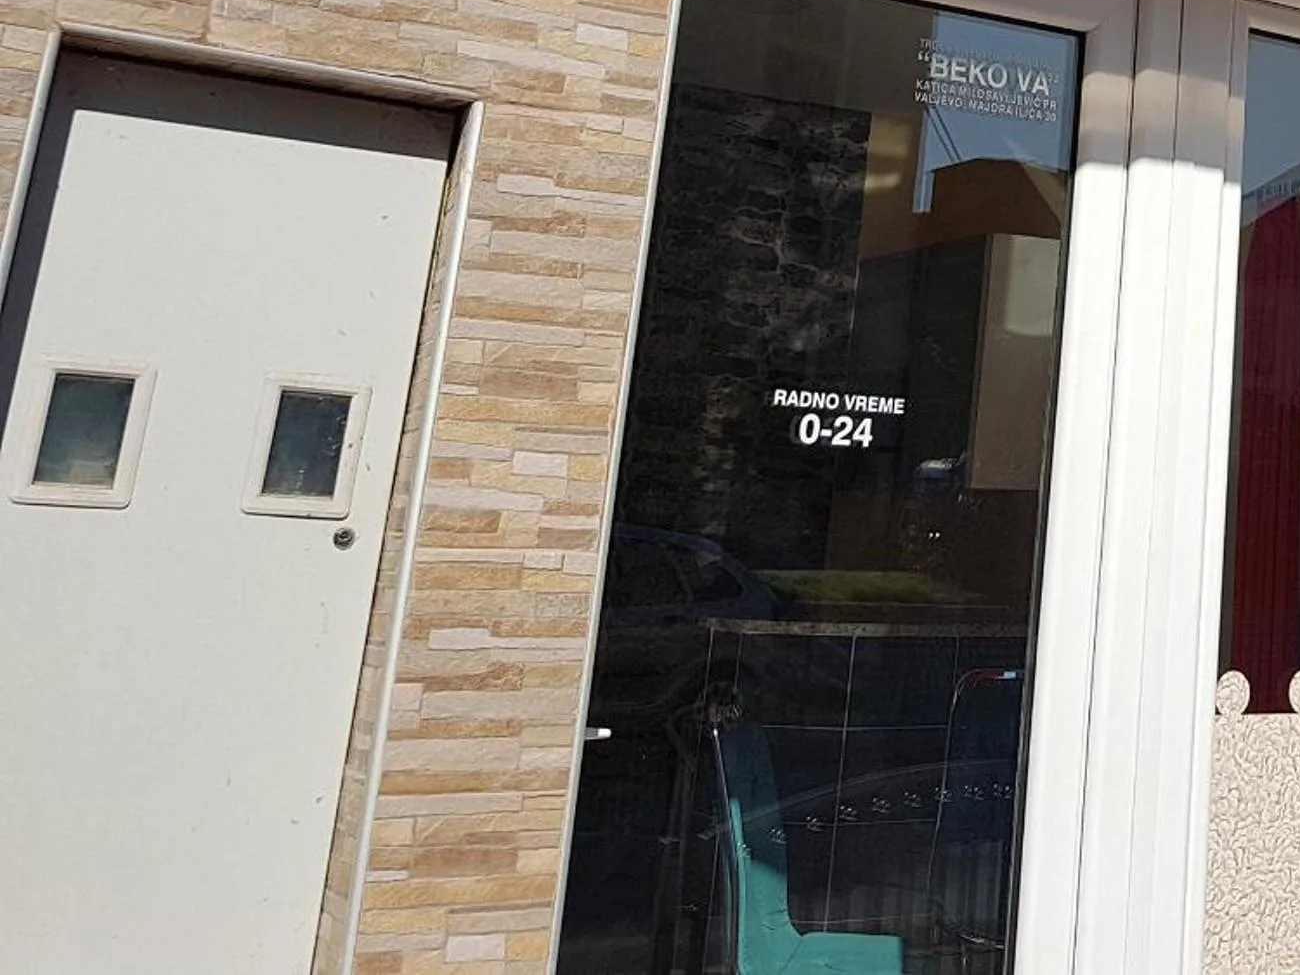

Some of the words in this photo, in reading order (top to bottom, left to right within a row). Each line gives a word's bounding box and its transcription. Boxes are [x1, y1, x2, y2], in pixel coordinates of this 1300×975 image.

[773, 388, 840, 410] RADNO
[844, 394, 906, 415] VREME
[799, 412, 874, 449] 0-24
